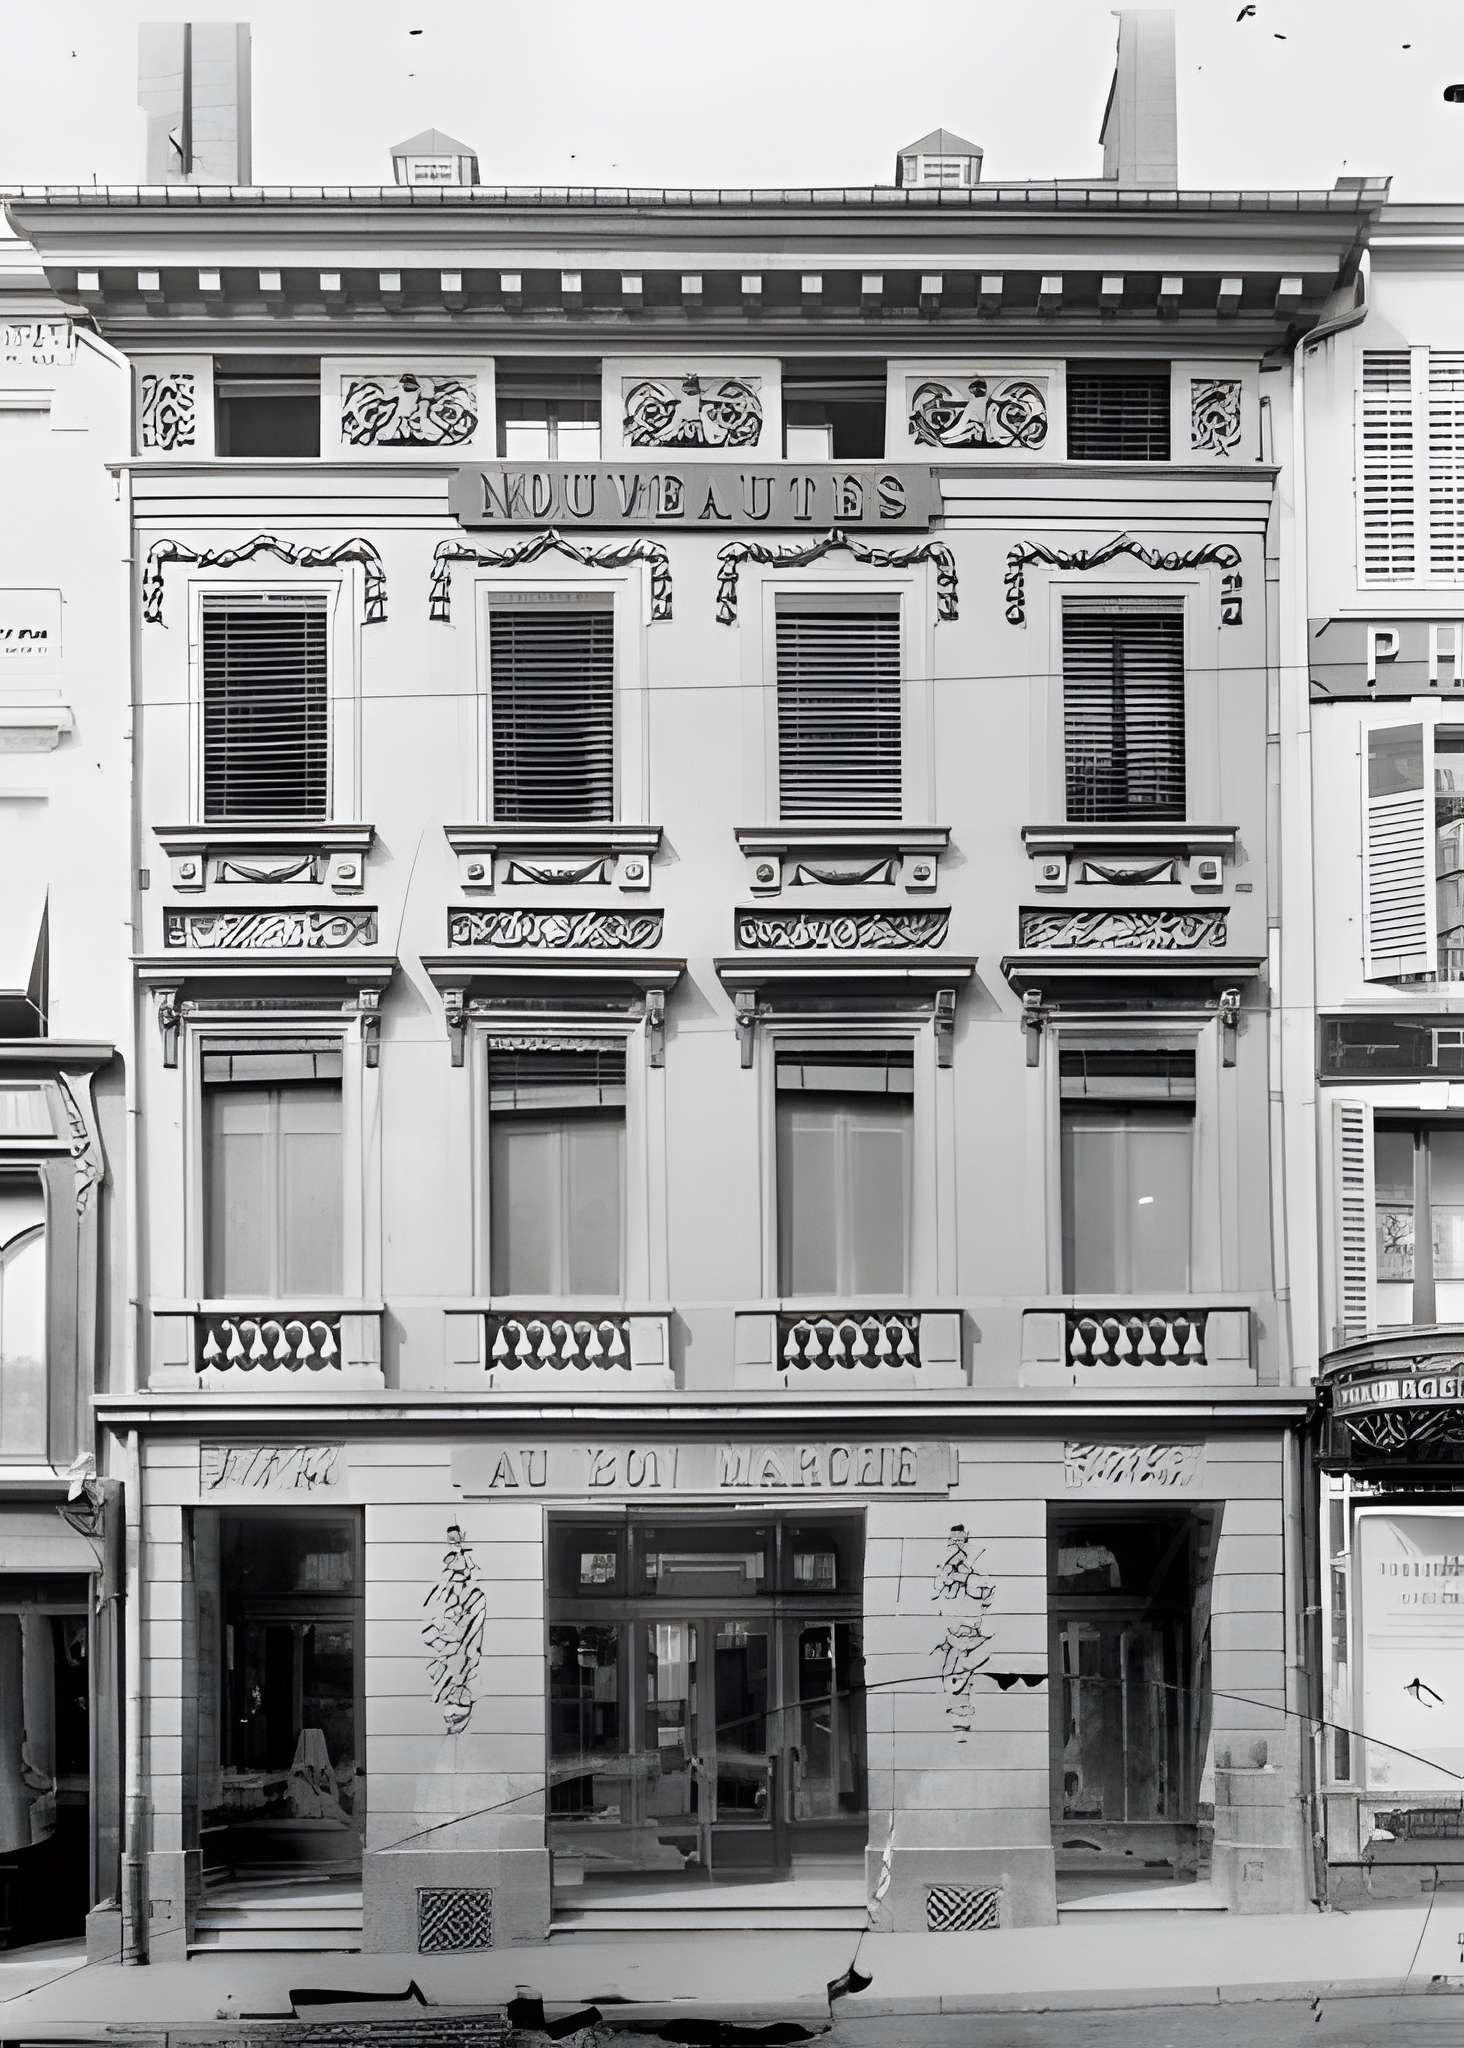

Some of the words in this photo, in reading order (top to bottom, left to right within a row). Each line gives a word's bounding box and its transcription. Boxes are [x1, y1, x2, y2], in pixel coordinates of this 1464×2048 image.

[480, 472, 907, 520] NOUVEAUTES
[1367, 624, 1464, 688] PH
[488, 1449, 548, 1488] AU
